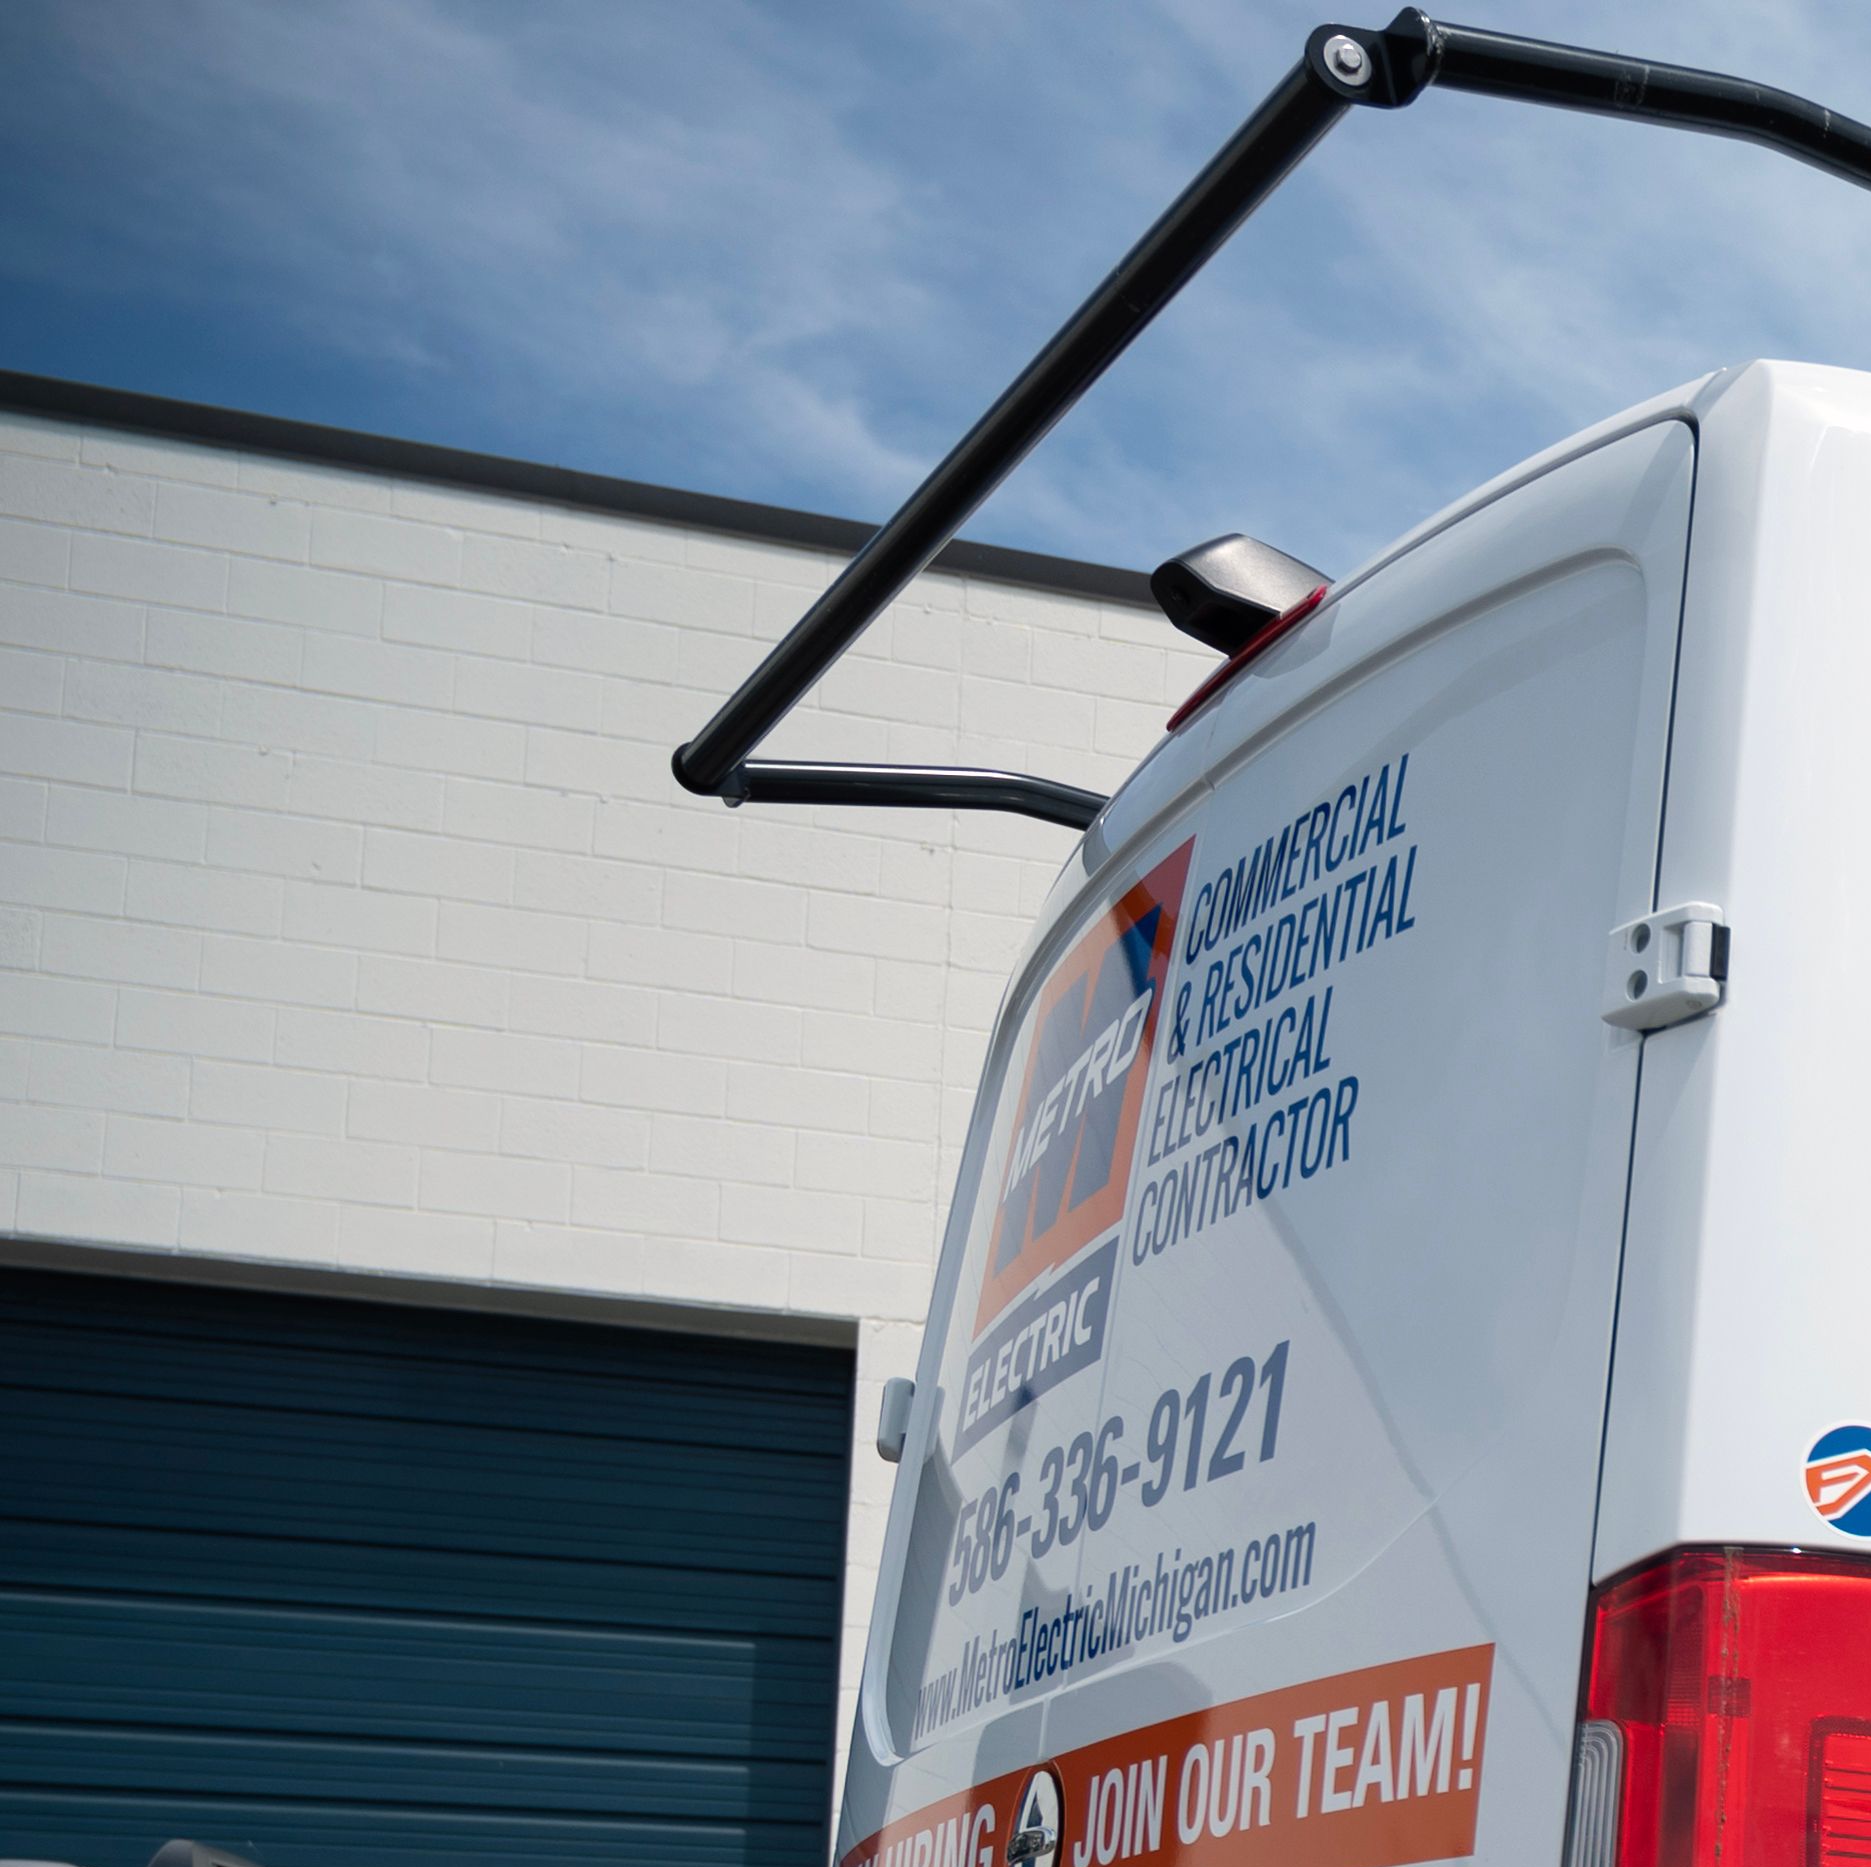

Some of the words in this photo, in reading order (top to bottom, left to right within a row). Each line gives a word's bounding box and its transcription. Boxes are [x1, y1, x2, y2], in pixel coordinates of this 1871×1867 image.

[1166, 981, 1193, 1064] &
[1197, 846, 1417, 1049] RESIDENTIAL
[1185, 754, 1409, 966] COMMERCIAL
[1004, 985, 1154, 1203] METRO
[1132, 1076, 1359, 1266] CONTRACTOR
[1147, 987, 1334, 1168] ELECTRICAL
[963, 1277, 1101, 1434] ELECTRIC
[949, 1340, 1290, 1607] 586-336-9121
[915, 1522, 1316, 1740] www.MetroElectricMichigan.com
[1177, 1728, 1276, 1846] OUR
[1294, 1683, 1481, 1822] TEAM!
